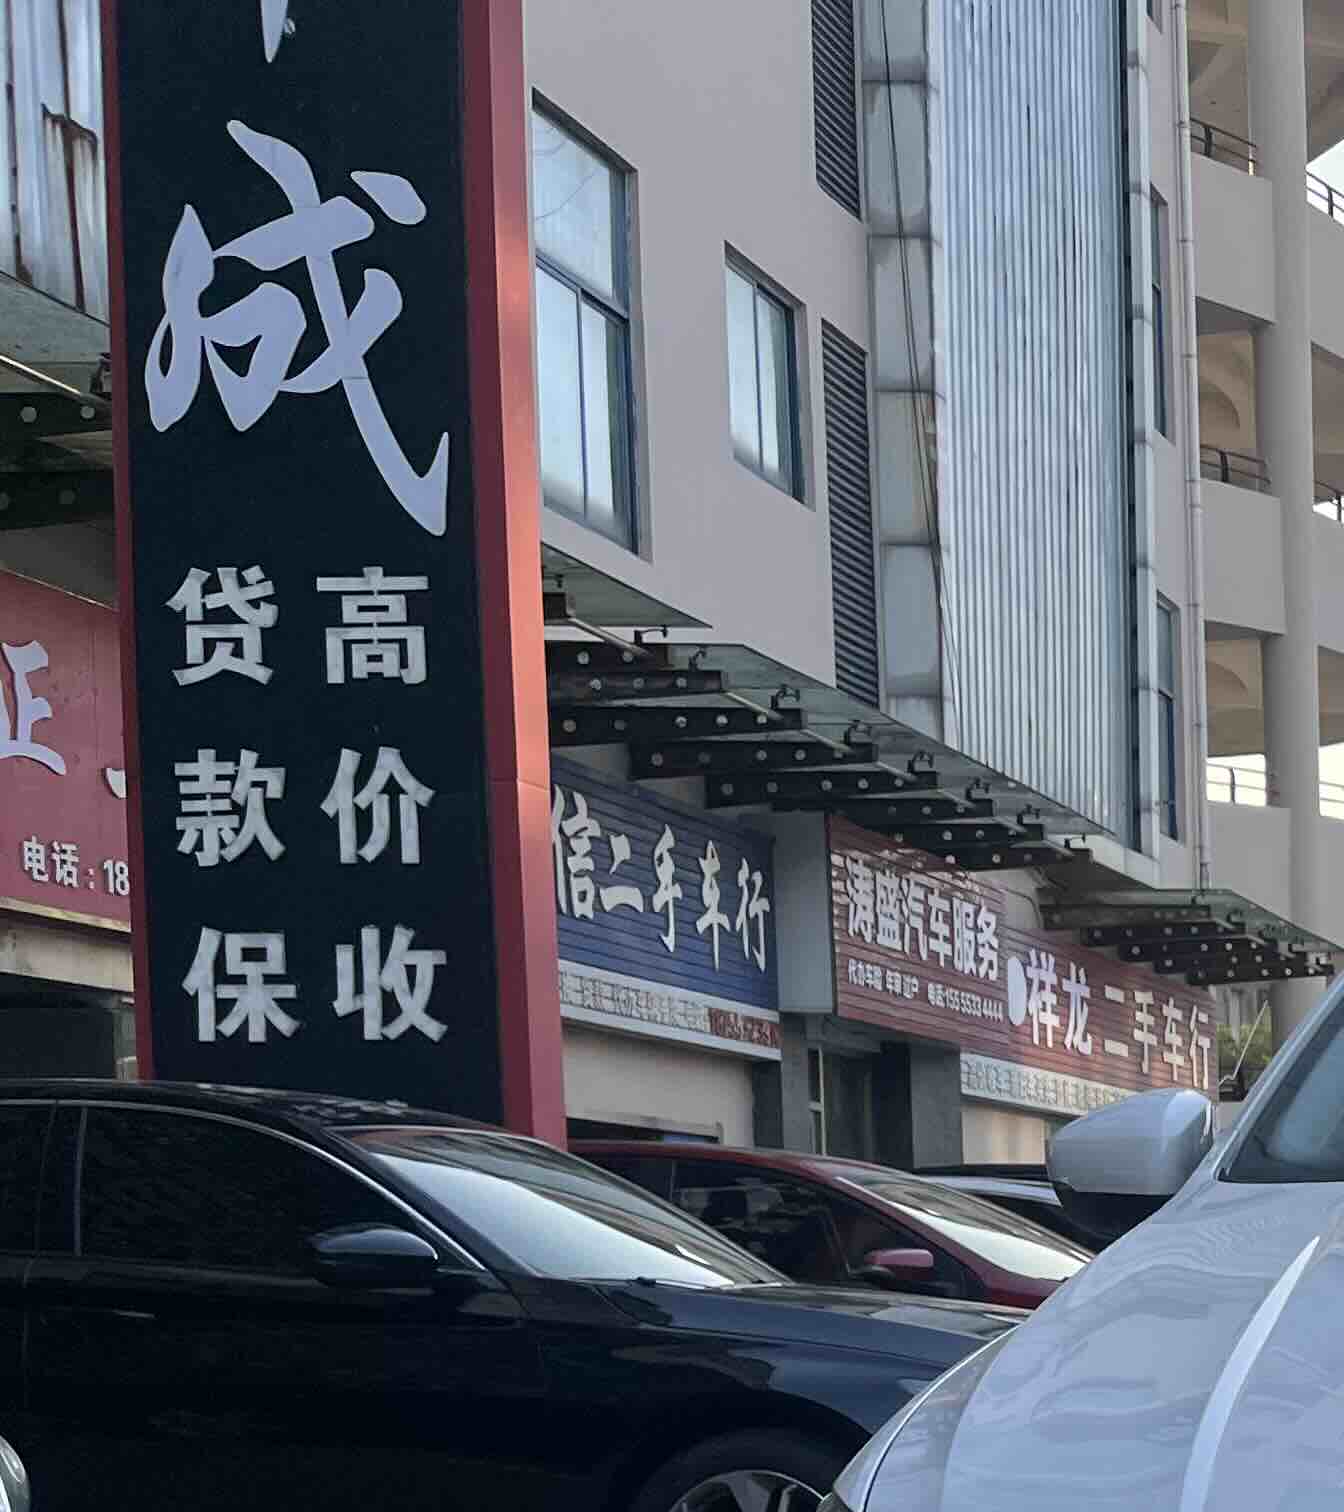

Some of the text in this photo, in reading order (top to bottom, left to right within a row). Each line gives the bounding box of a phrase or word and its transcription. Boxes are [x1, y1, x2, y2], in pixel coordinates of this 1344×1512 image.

[145, 0, 449, 536] 成
[166, 565, 301, 1043] 贷款保
[315, 566, 448, 1042] 高价收
[552, 784, 770, 973] 信二手车行
[1026, 949, 1093, 1056] 祥龙
[1104, 984, 1212, 1091] 二手车行
